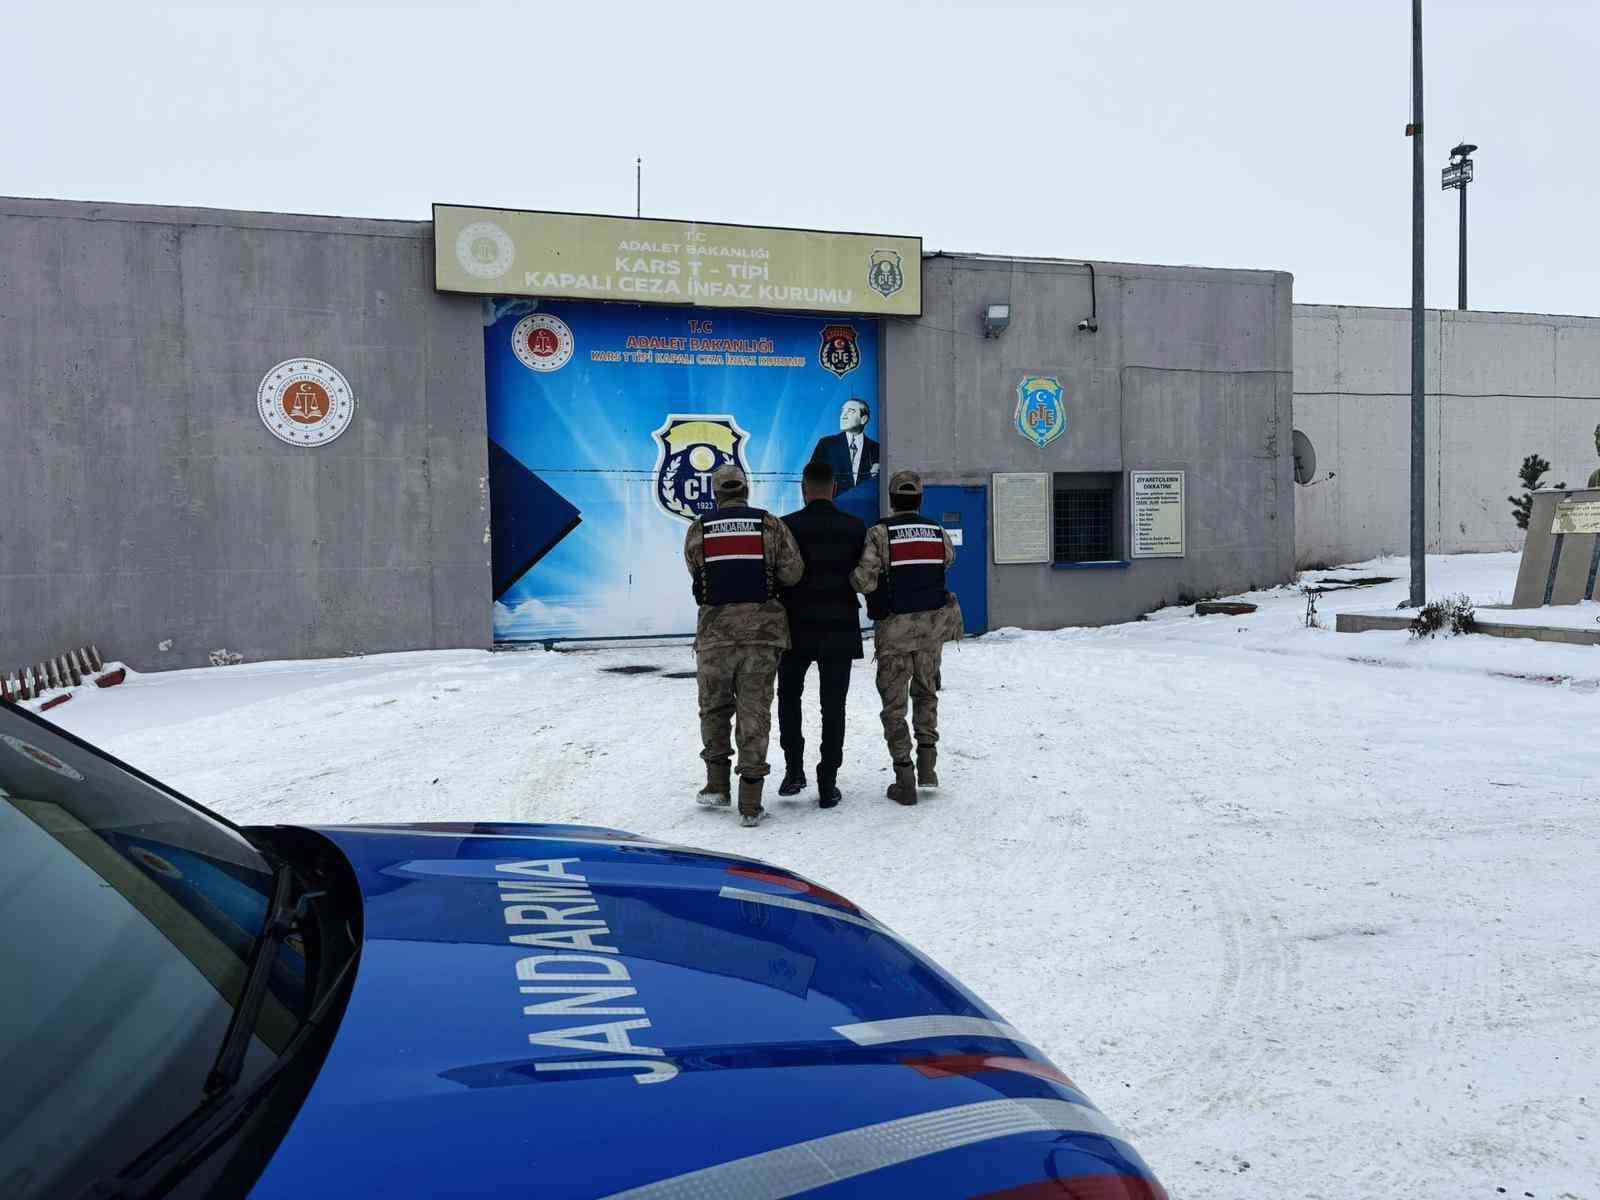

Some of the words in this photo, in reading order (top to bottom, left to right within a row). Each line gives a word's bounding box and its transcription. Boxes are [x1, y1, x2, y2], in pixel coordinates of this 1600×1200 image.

[618, 240, 682, 254] ADALET
[686, 245, 769, 260] BAKANLIĞI
[615, 257, 681, 275] KARS
[726, 261, 769, 281] TİPİ
[525, 271, 612, 291] KAPALI
[618, 276, 680, 295] CEZA
[688, 276, 753, 298] İNFAZ
[759, 285, 852, 304] KURUMU
[688, 319, 713, 334] T.C
[626, 335, 687, 350] ADALET
[690, 337, 774, 353] BAKANLIĞI
[684, 473, 716, 500] CT
[710, 522, 756, 534] JANDARMA
[894, 527, 937, 540] JANDARMA
[495, 857, 679, 1085] JANDARMA
